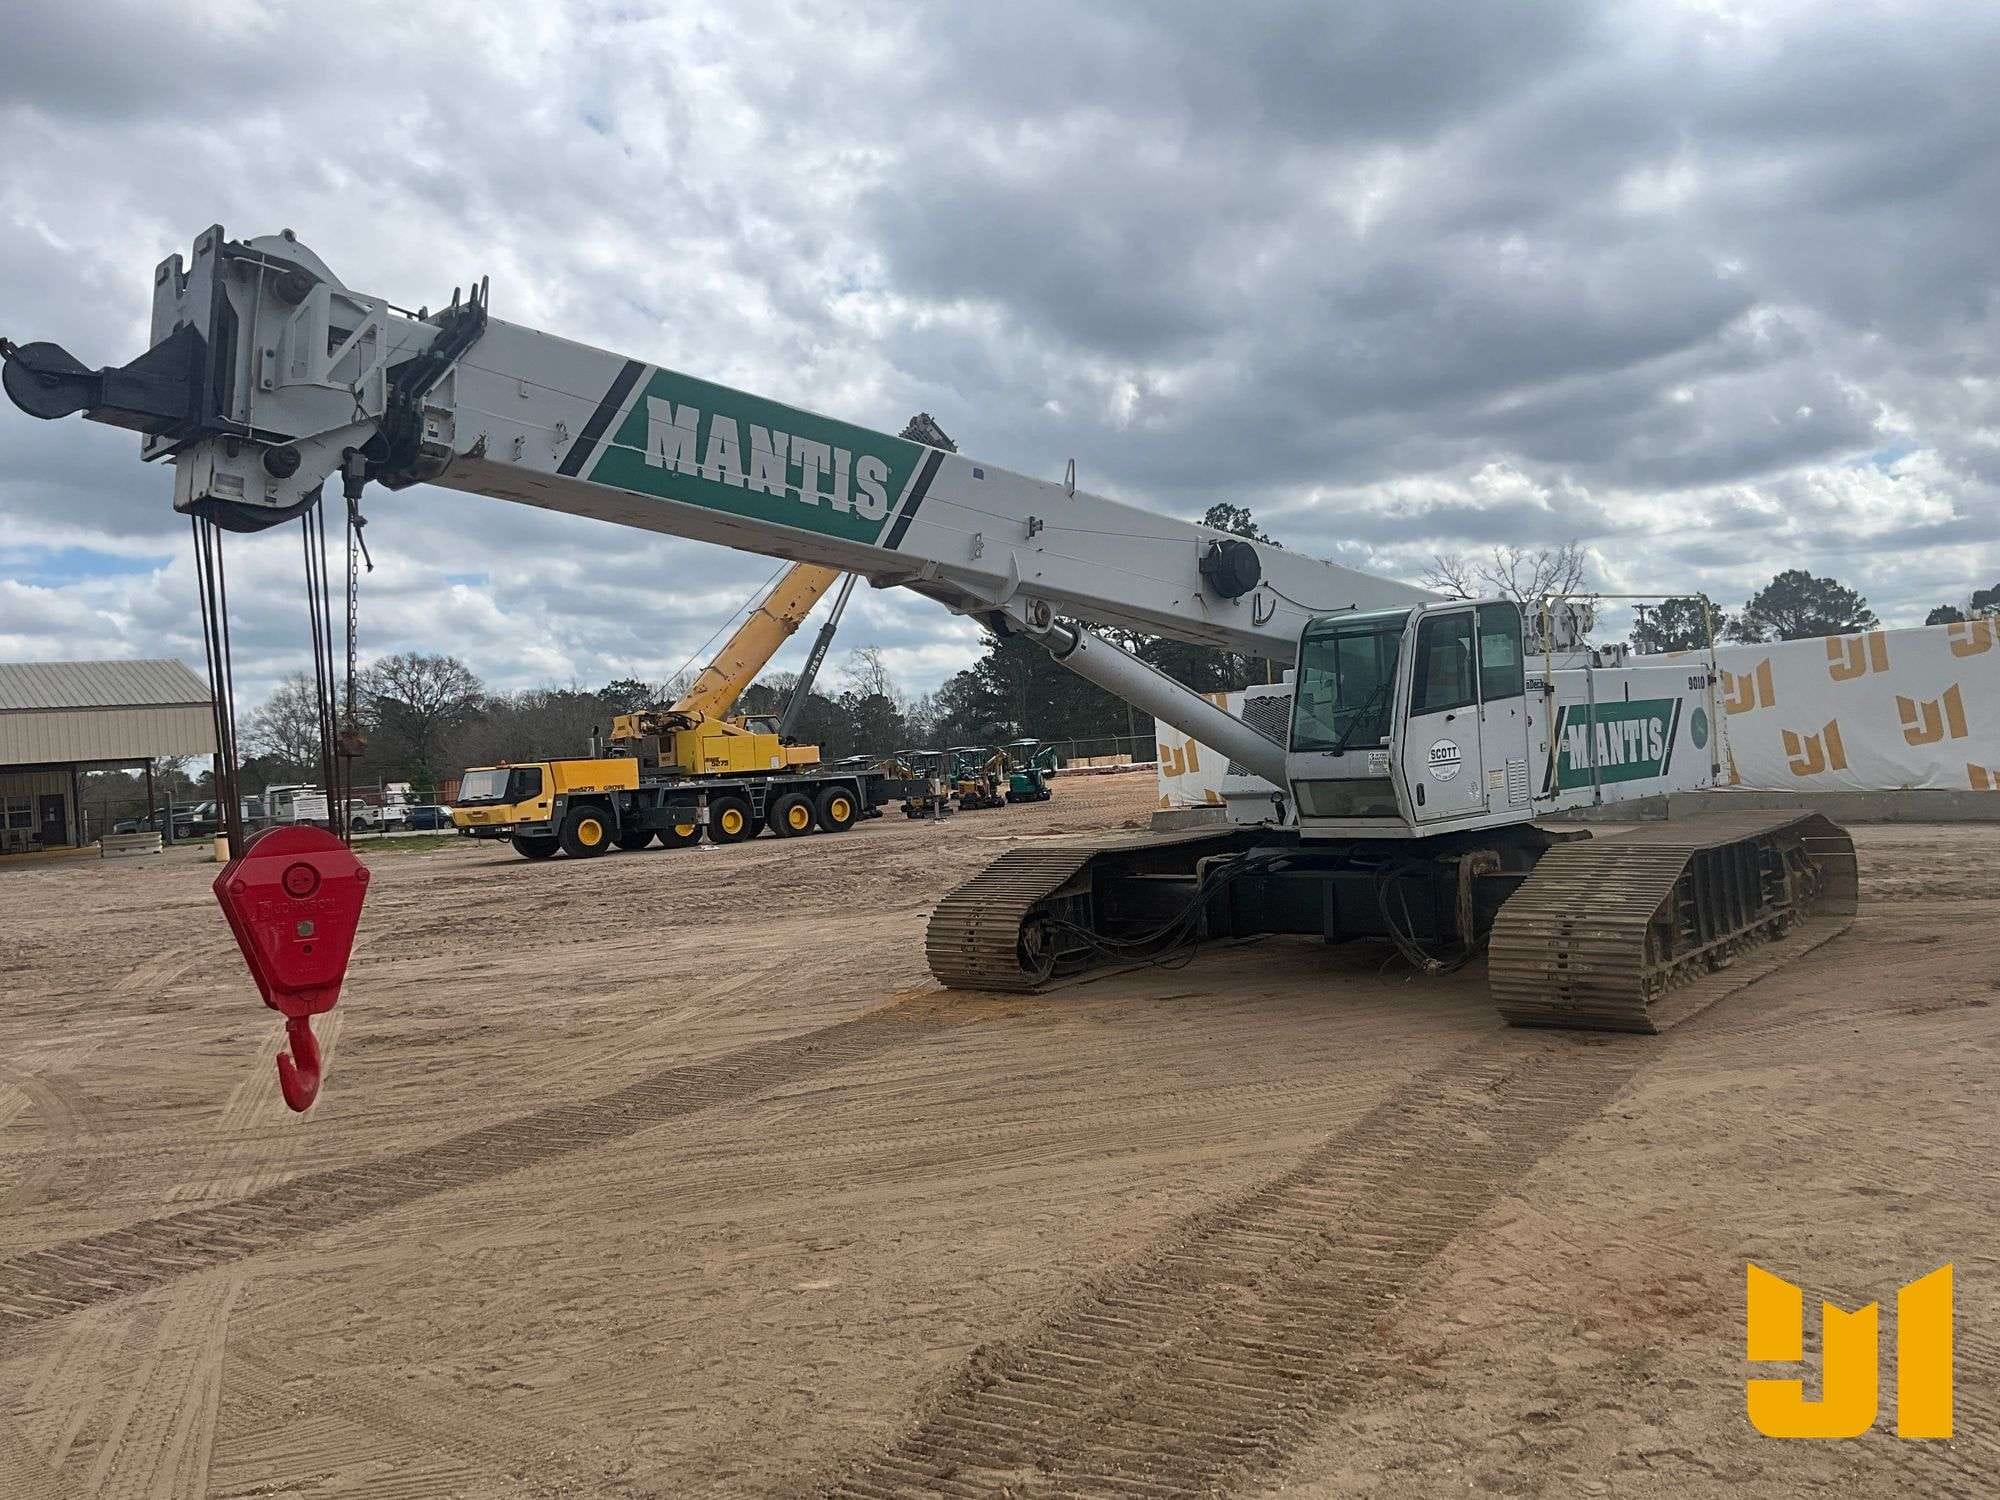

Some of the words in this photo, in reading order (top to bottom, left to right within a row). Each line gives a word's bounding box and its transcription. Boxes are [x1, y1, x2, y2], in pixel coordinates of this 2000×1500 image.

[645, 395, 889, 521] MANTIS
[1688, 675, 1706, 690] 9010
[1430, 746, 1457, 760] SCOTT
[1567, 717, 1663, 770] MANTIS
